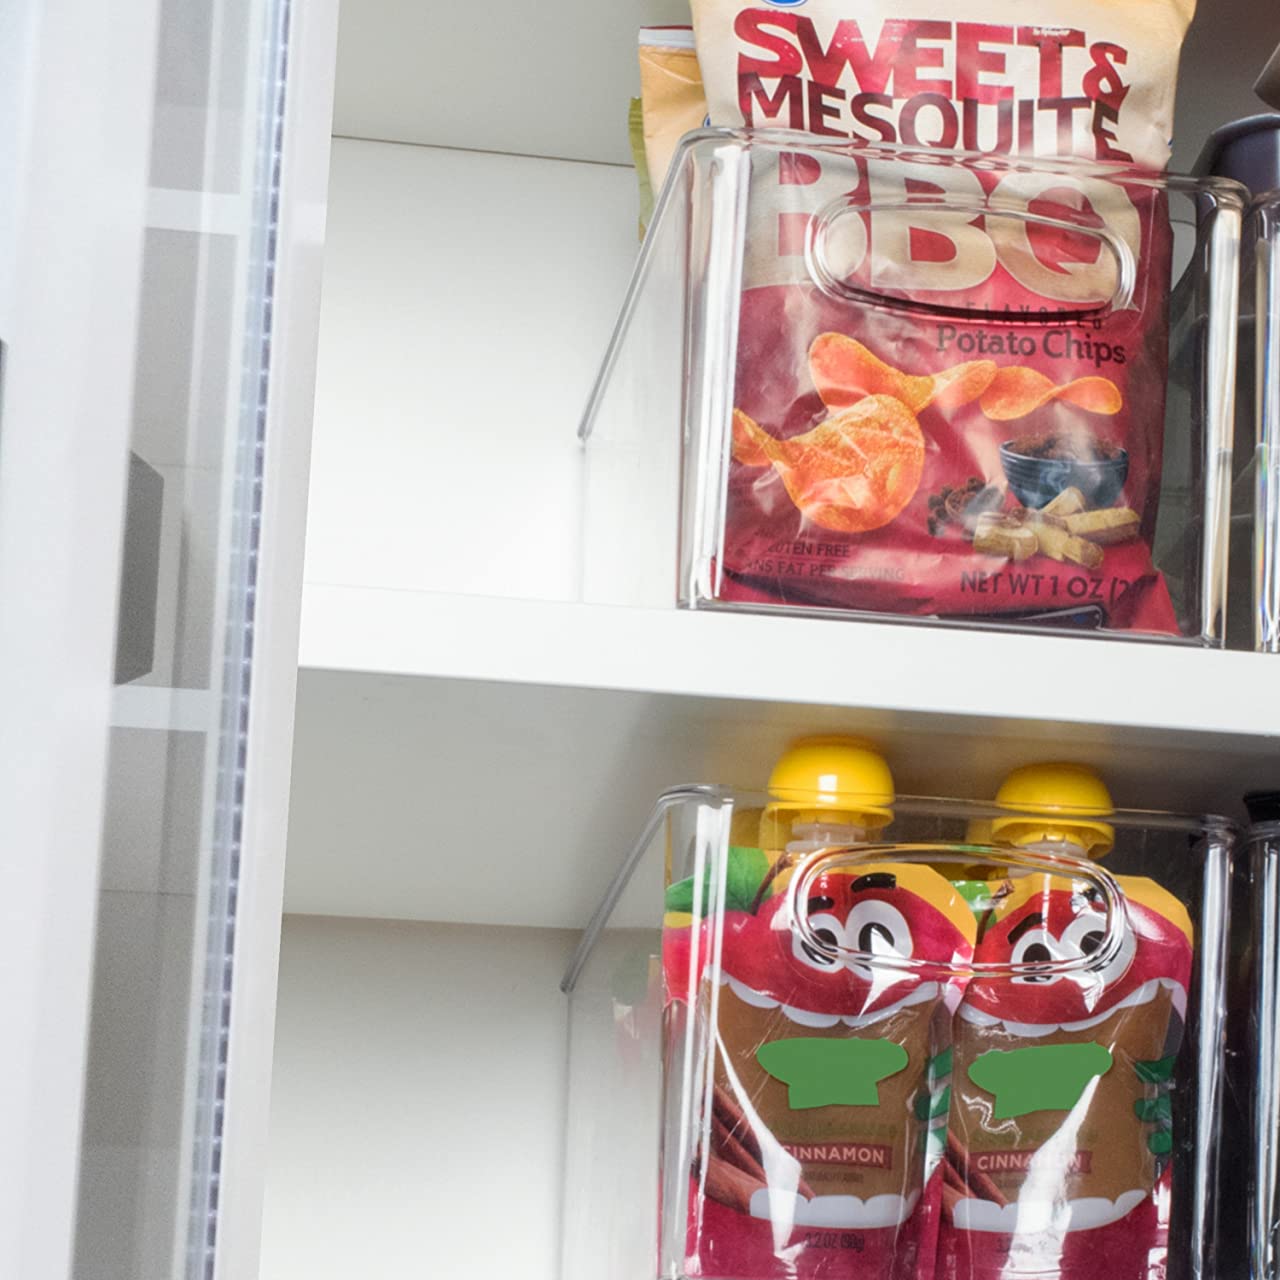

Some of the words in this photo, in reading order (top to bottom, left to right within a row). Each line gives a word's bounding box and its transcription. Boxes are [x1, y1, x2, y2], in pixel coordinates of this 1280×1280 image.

[743, 72, 1133, 163] MESQUITE
[936, 324, 1036, 357] Potato
[1042, 329, 1127, 368] Chips
[765, 540, 813, 556] LUTEN
[815, 541, 851, 558] FREE
[776, 560, 806, 577] FAT
[961, 570, 1001, 593] NET
[1008, 572, 1045, 596] WT
[1050, 575, 1060, 596] 1
[1066, 576, 1104, 600] OZ
[976, 1153, 1082, 1172] CINNN
